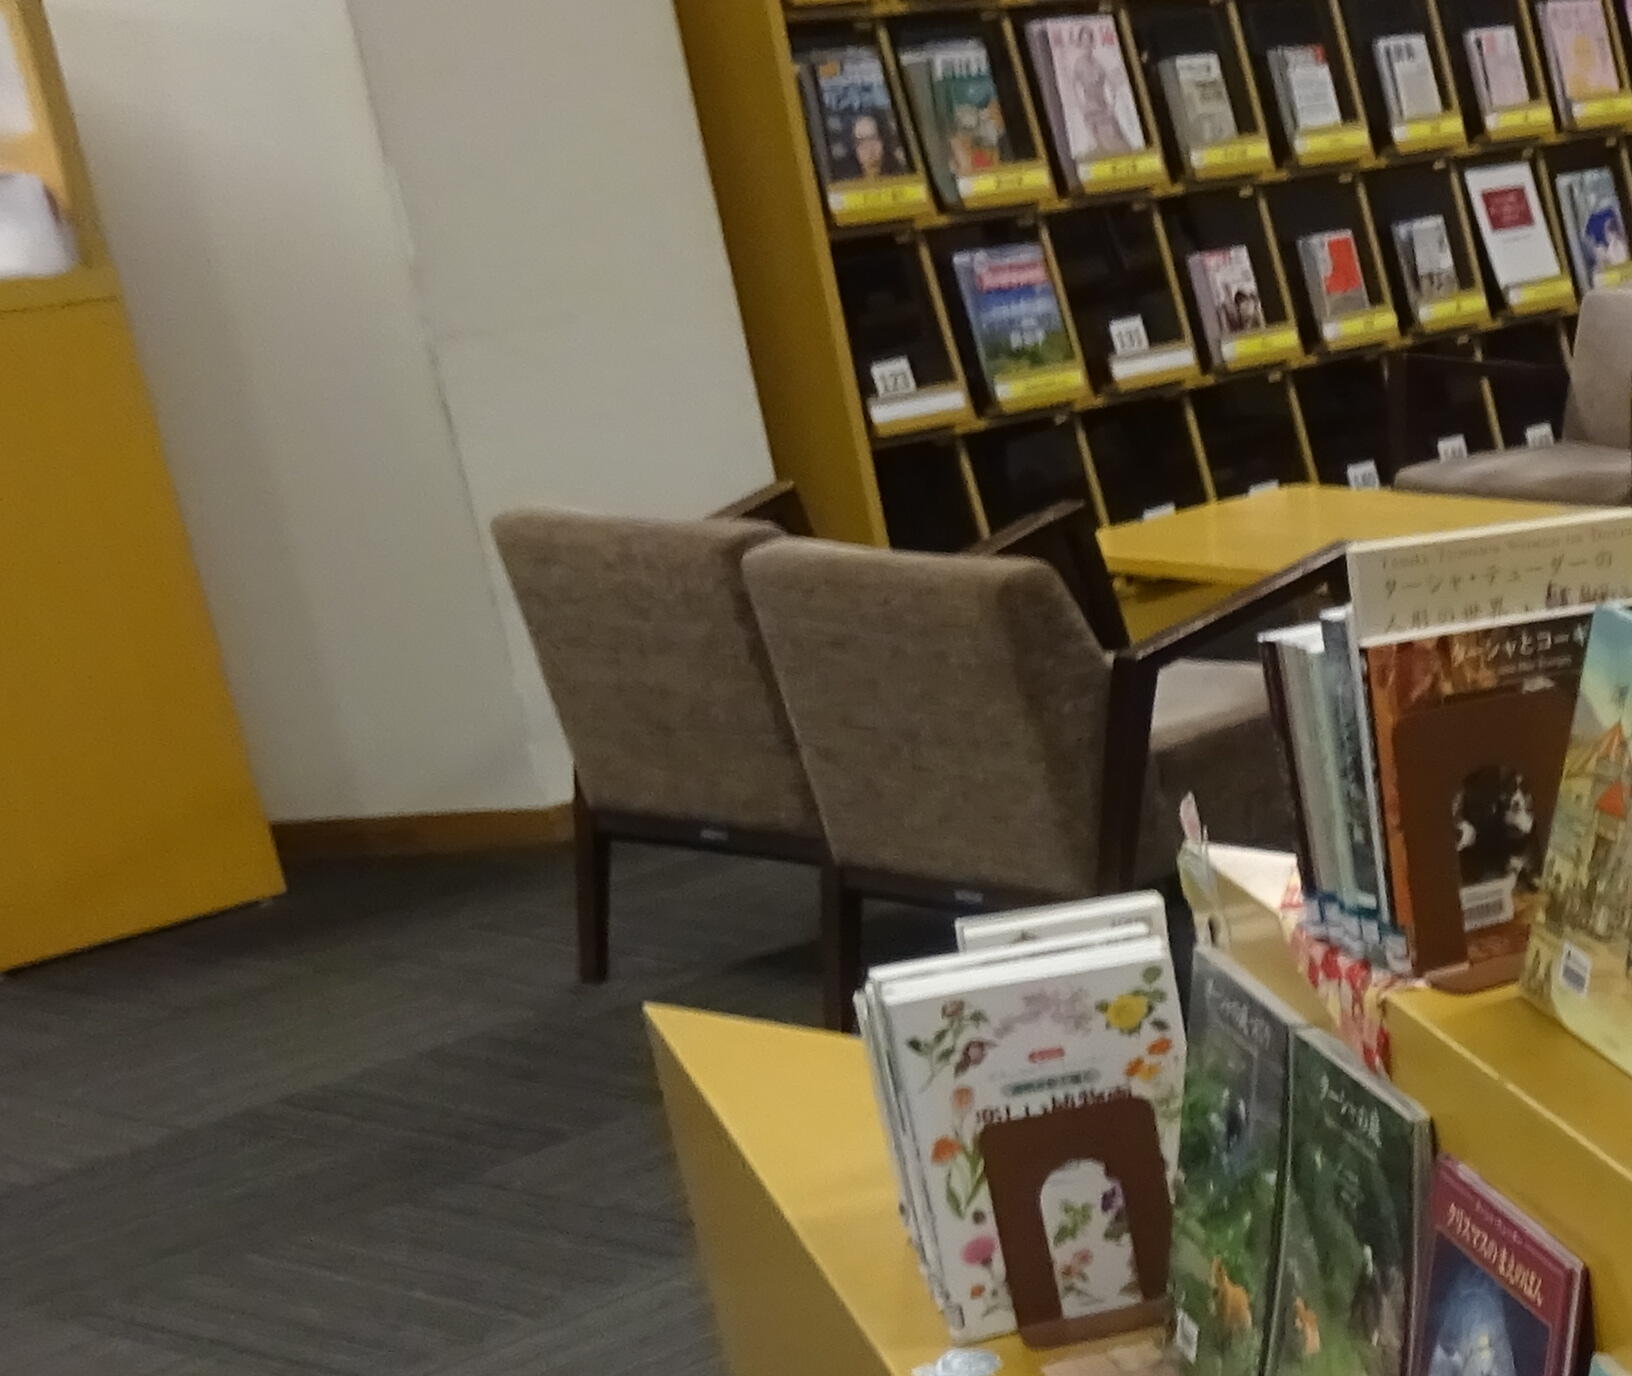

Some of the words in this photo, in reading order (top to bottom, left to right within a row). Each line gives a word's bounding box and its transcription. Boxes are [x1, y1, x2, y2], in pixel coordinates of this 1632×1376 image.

[1383, 551, 1614, 598] ターシャ・テューダーの
